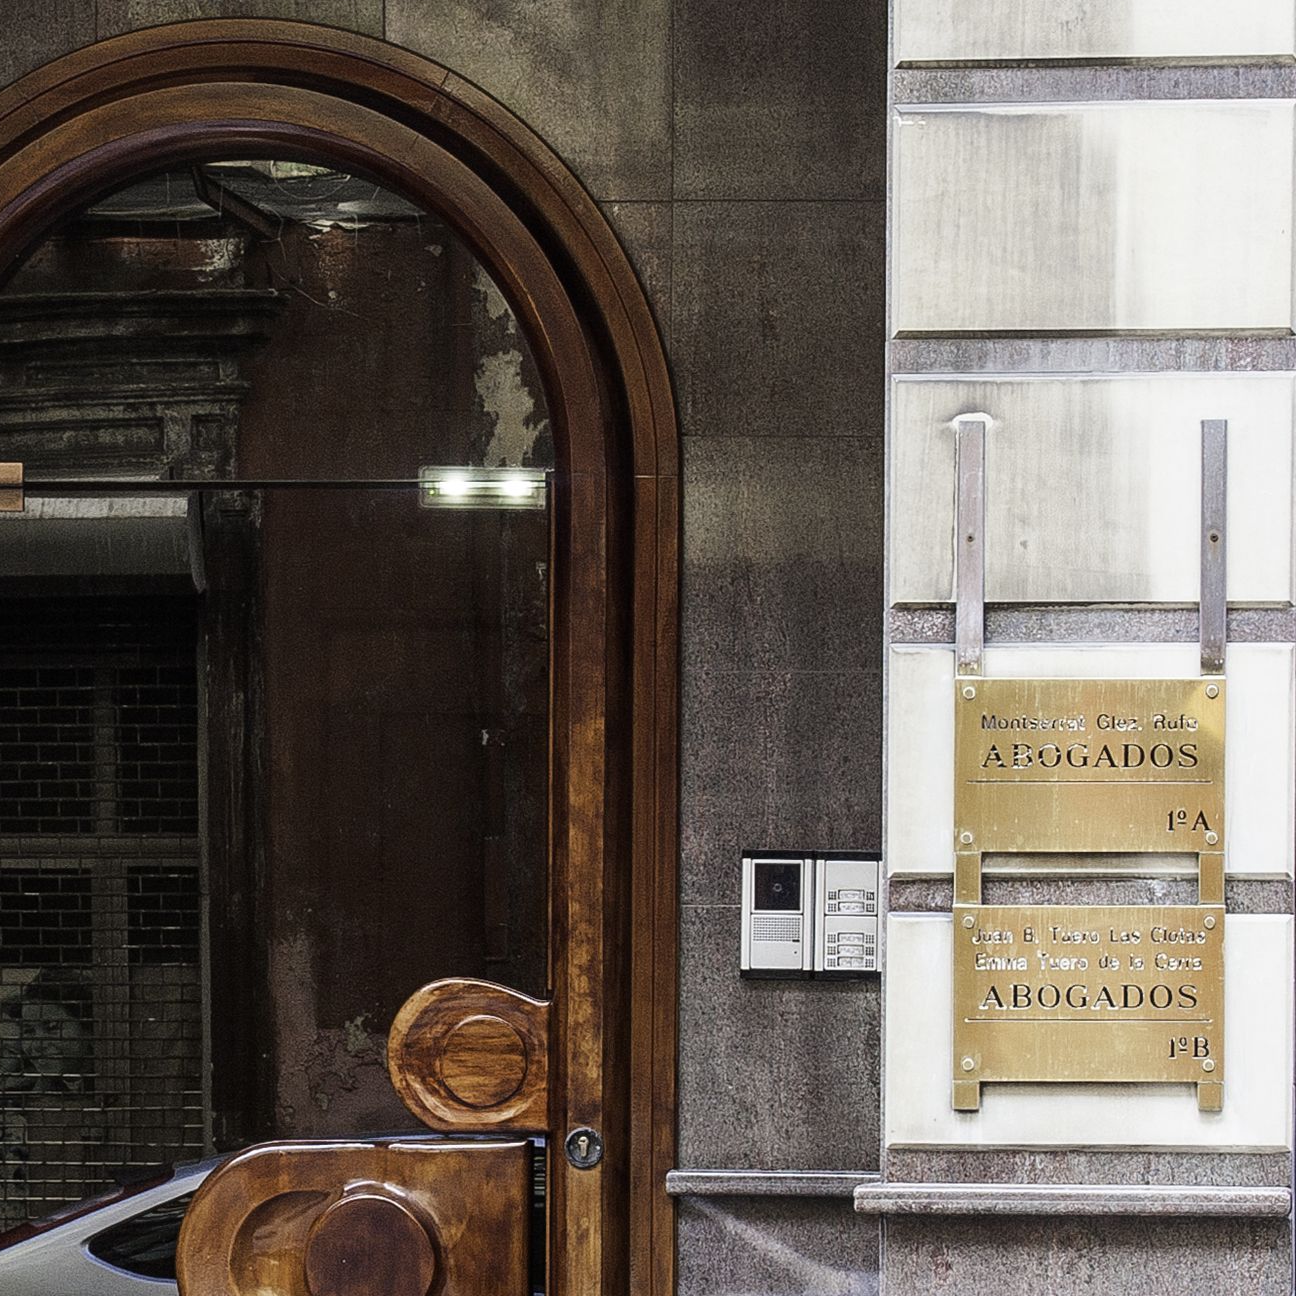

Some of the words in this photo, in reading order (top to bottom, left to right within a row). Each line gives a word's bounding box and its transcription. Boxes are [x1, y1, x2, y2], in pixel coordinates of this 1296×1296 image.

[980, 714, 1086, 731] Montserrat
[1096, 713, 1143, 731] Glez.
[980, 743, 1199, 769] ABOGADOS
[972, 927, 1014, 945] Juan
[1023, 926, 1040, 945] B.
[1049, 926, 1100, 945] Tuero
[1109, 927, 1141, 945] Las
[975, 952, 1028, 971] Emma
[1037, 950, 1089, 971] Tuero
[1099, 952, 1120, 971] de
[978, 984, 1199, 1010] ABOGADOS
